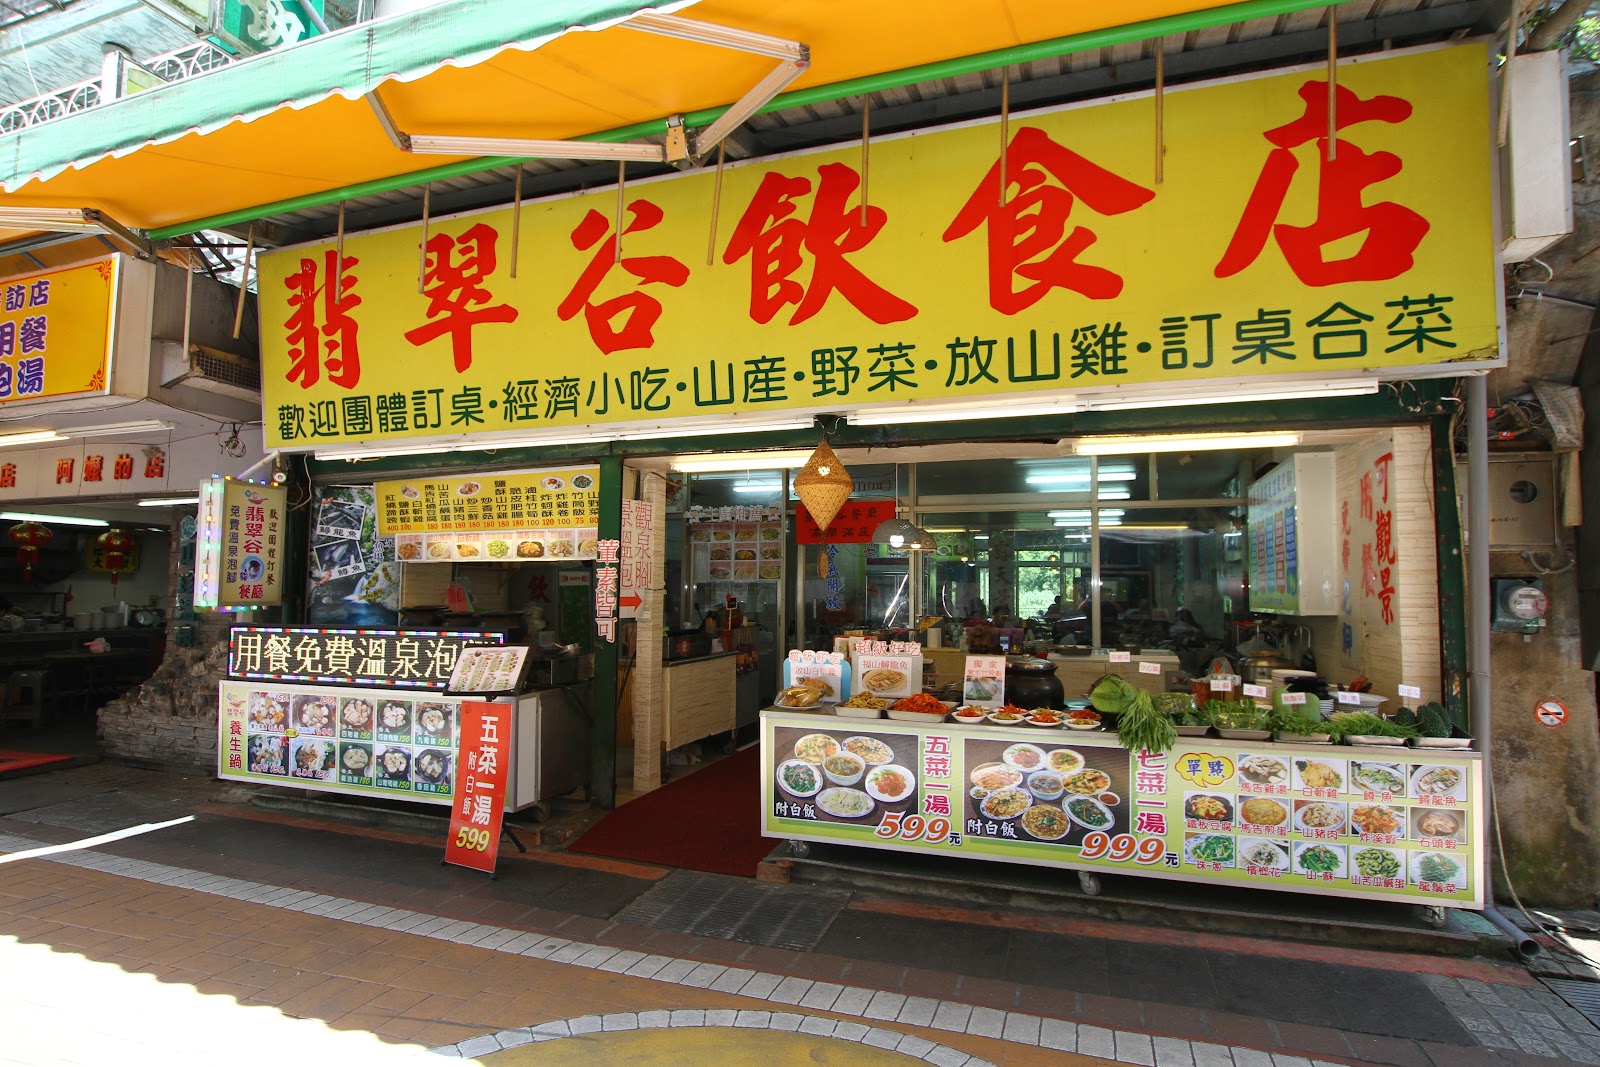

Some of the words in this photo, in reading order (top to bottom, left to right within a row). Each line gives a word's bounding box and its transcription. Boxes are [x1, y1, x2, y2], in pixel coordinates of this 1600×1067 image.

[284, 80, 1430, 389] 翡翠谷飲食店
[0, 279, 51, 312] 訪店
[243, 506, 265, 553] 翡翠谷
[1375, 452, 1395, 626] 可觀景
[226, 505, 240, 583] 免費溫泉泡腳
[826, 545, 841, 610] 冷氣開放
[239, 584, 264, 599] 餐廳
[595, 539, 619, 643] 葷素皆可
[234, 634, 496, 680] 用餐免費溫泉泡
[789, 651, 841, 665] 超級好吃
[856, 641, 921, 657] 超級好吃
[229, 720, 242, 769] 養生鍋
[360, 732, 371, 740] 150
[437, 738, 450, 746] 150
[471, 715, 499, 826] 五菜一湯
[924, 735, 952, 815] 五菜一湯
[1187, 759, 1226, 779] 單點
[398, 780, 410, 788] 150
[462, 751, 477, 816] 附白飯
[1135, 750, 1168, 834] 七菜一湯
[1240, 782, 1287, 796] 馬告雞湯
[1302, 786, 1338, 799] 白斬雞
[776, 801, 817, 821] 附白飯
[967, 818, 1018, 839] 附白飯
[1187, 818, 1232, 833] 鐵板豆腐
[1240, 822, 1287, 837] 馬告煎蛋
[1302, 827, 1338, 841] 山豬肉
[455, 826, 490, 852] 599
[1359, 832, 1398, 846] 炸溪蝦
[1418, 836, 1457, 850] 石頭蝦
[1351, 874, 1405, 890] 山苦瓜鹹蛋
[1418, 880, 1457, 895] 龍鬚菜
